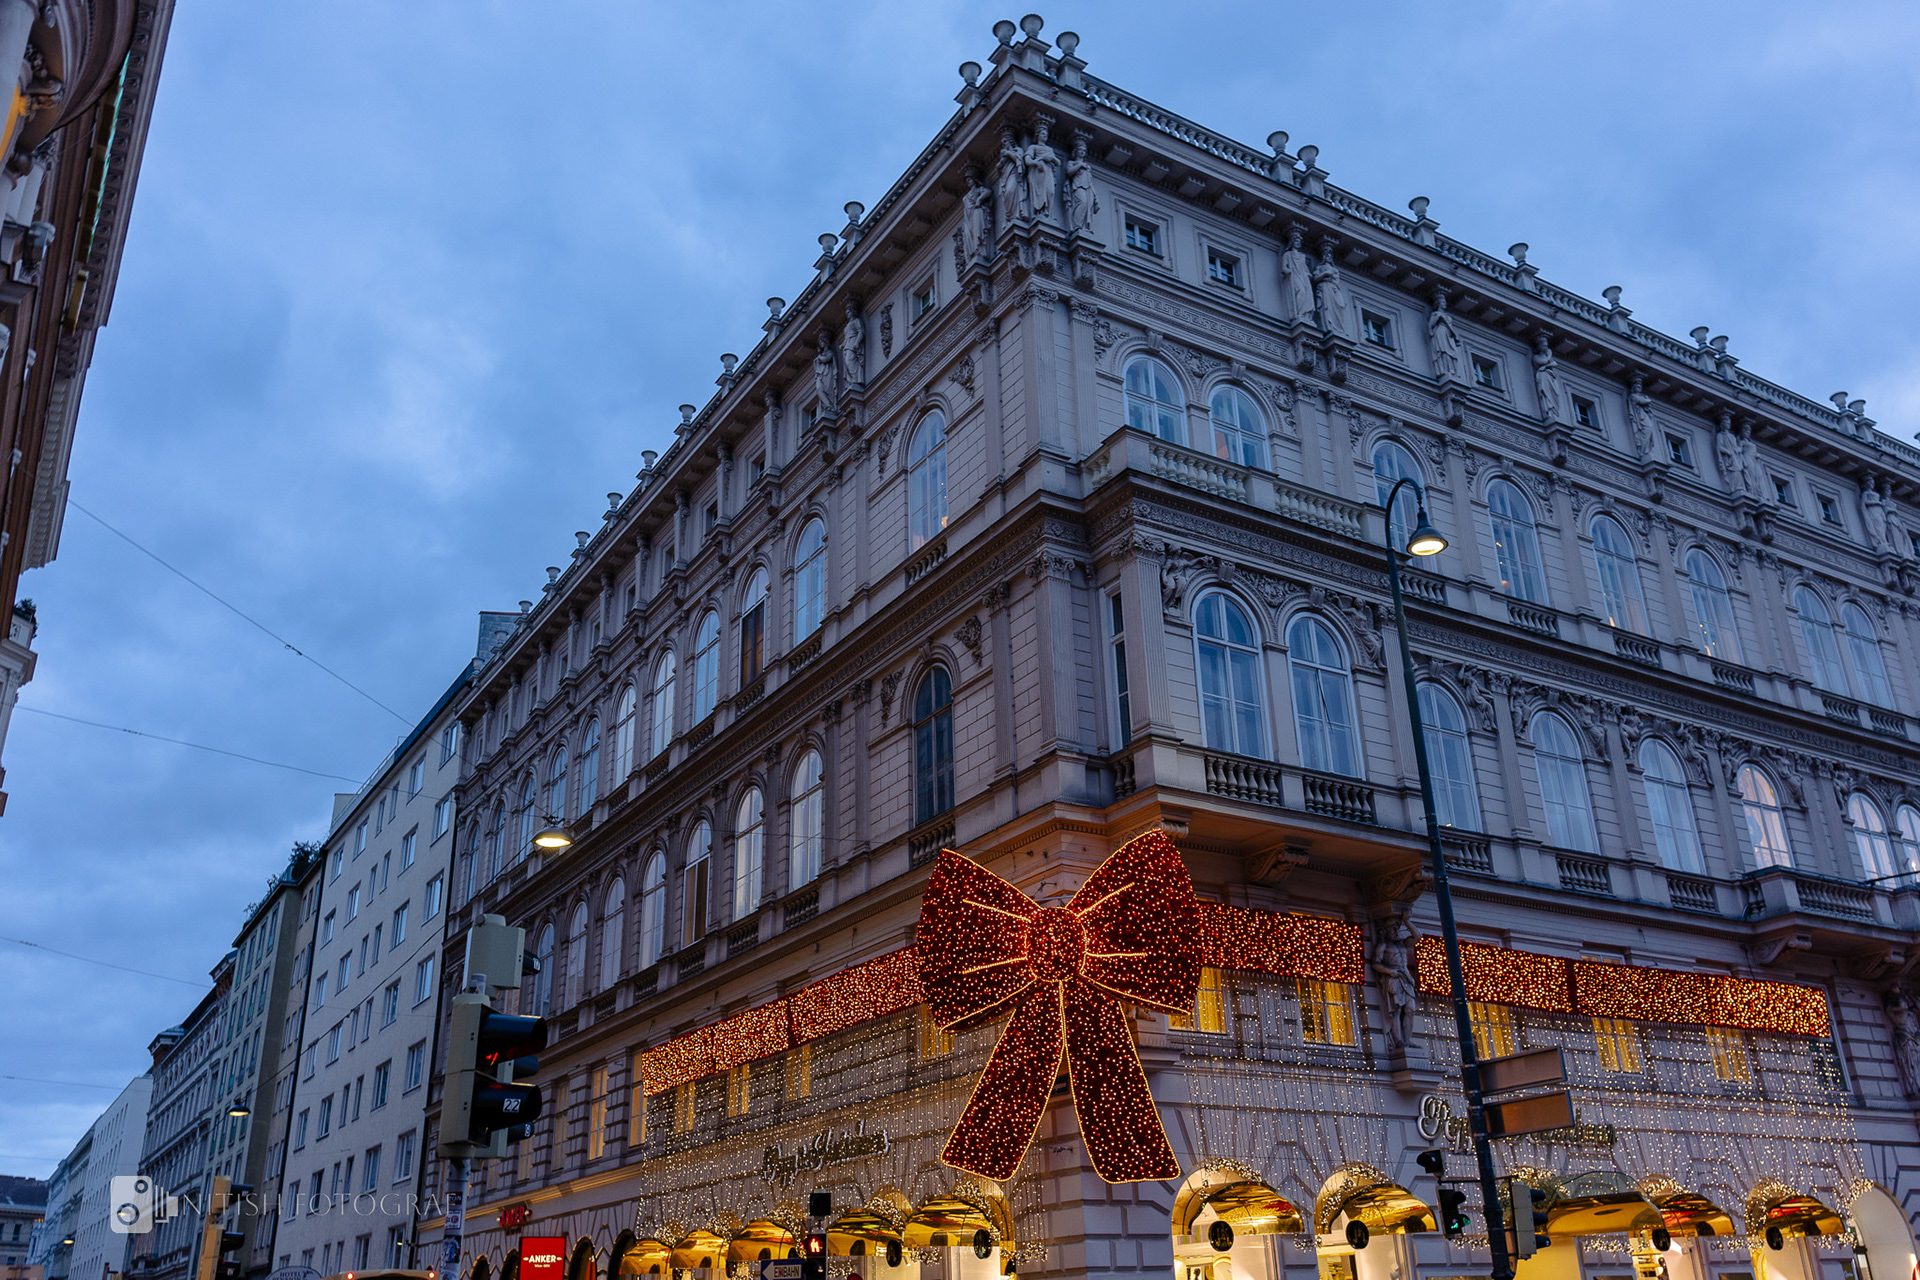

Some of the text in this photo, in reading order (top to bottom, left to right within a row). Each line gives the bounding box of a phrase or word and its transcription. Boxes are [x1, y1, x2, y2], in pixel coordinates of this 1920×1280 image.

[504, 1099, 520, 1112] 22
[500, 1205, 525, 1228] ANKER
[528, 1254, 557, 1263] ANKER
